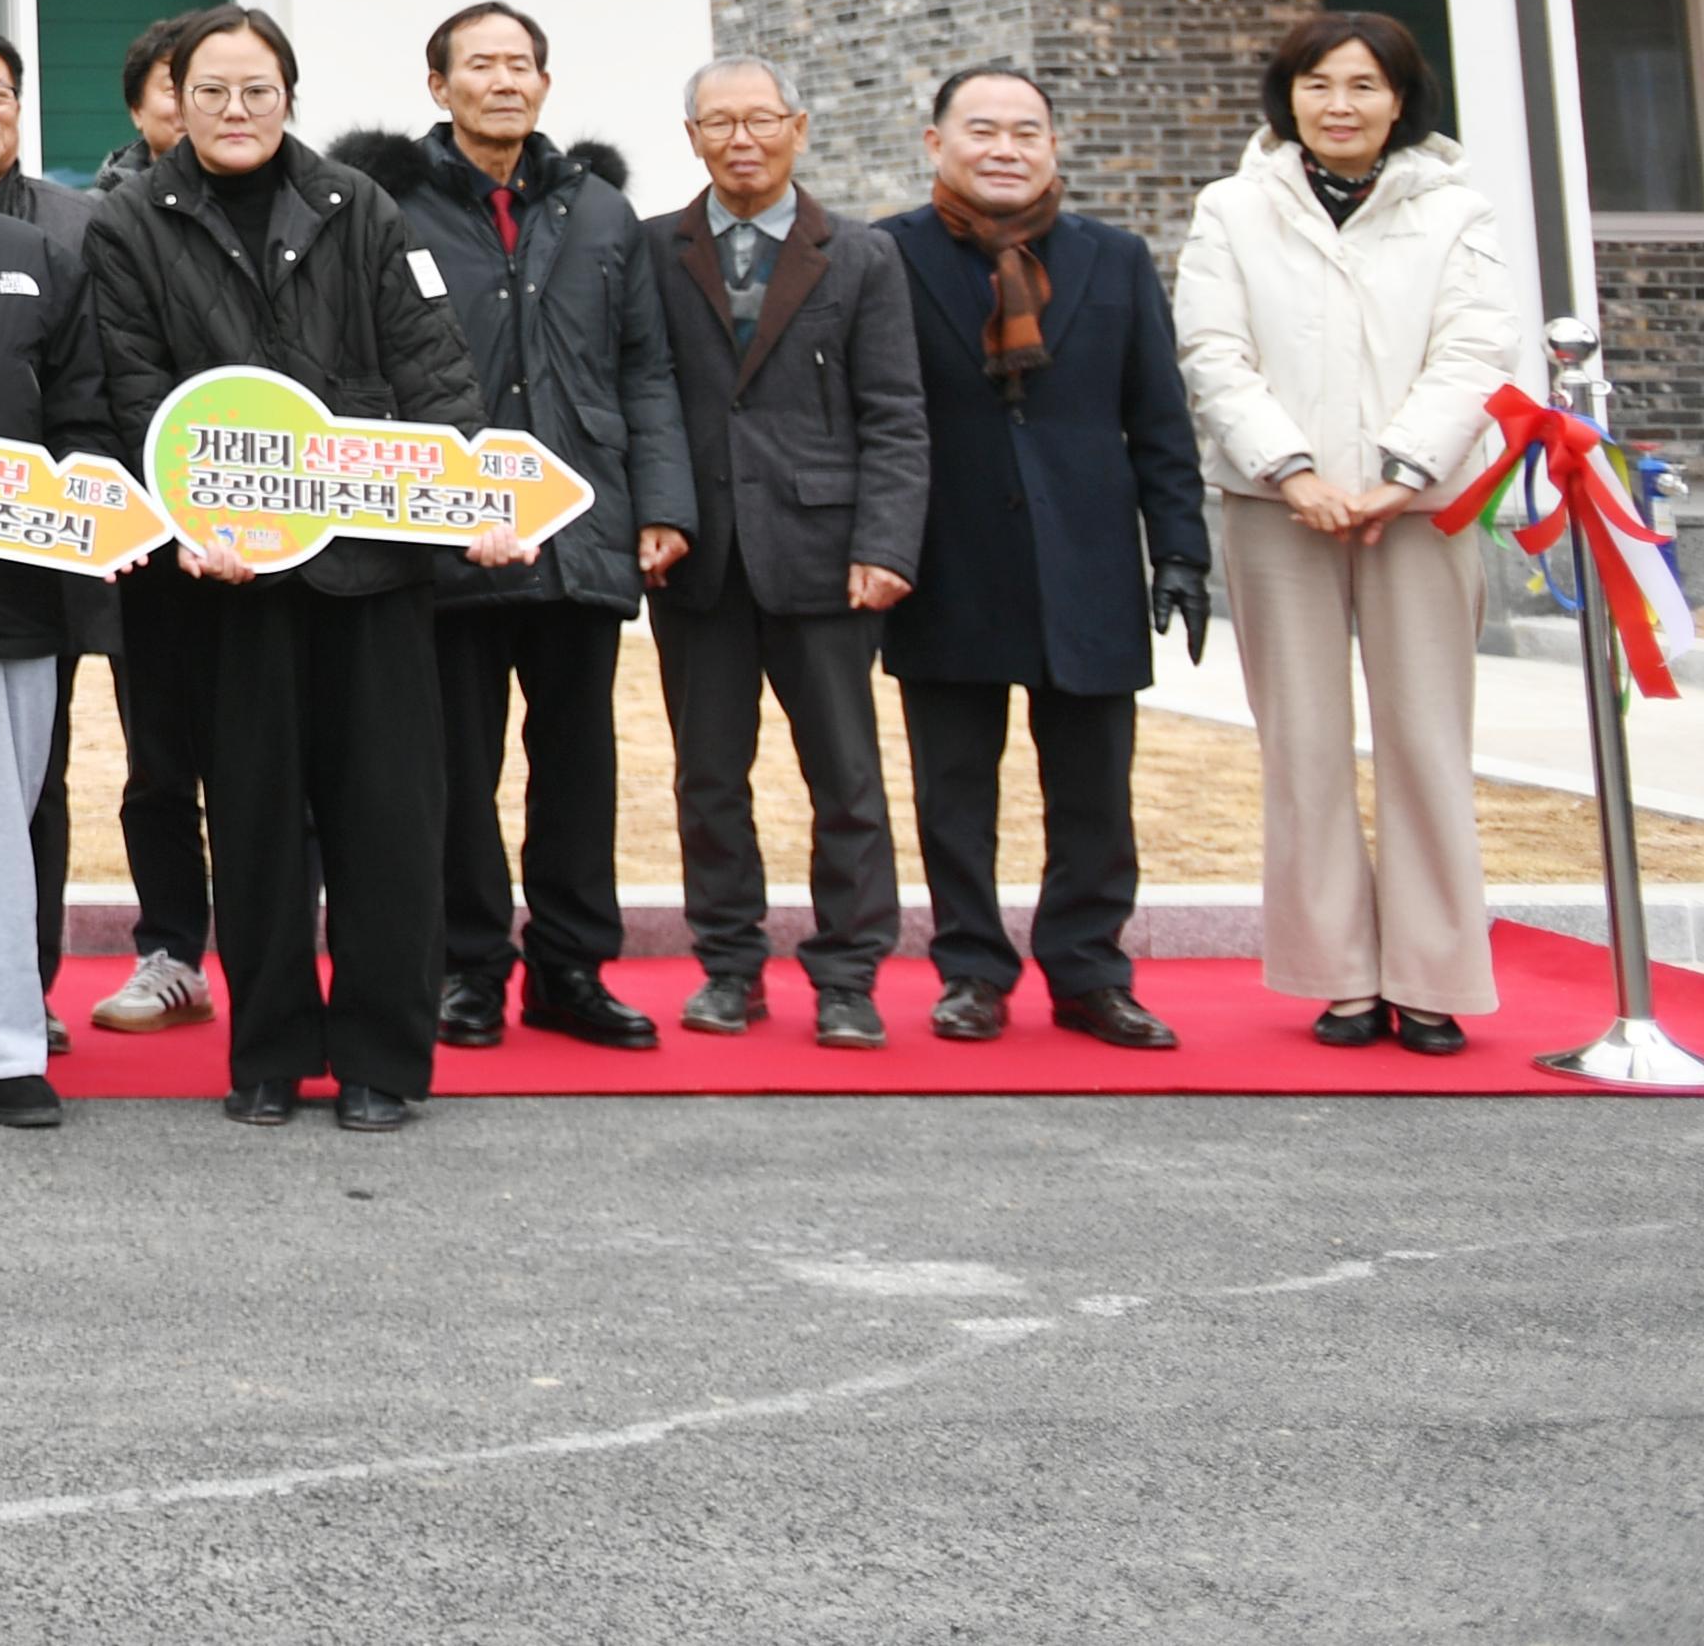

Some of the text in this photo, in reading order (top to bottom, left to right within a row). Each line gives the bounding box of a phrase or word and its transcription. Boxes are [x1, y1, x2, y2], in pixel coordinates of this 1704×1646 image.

[190, 427, 441, 479] 거례리 신혼부부
[481, 453, 542, 479] 제9호
[66, 476, 126, 506] 제8호
[191, 469, 512, 525] 공공임대주택 준공식
